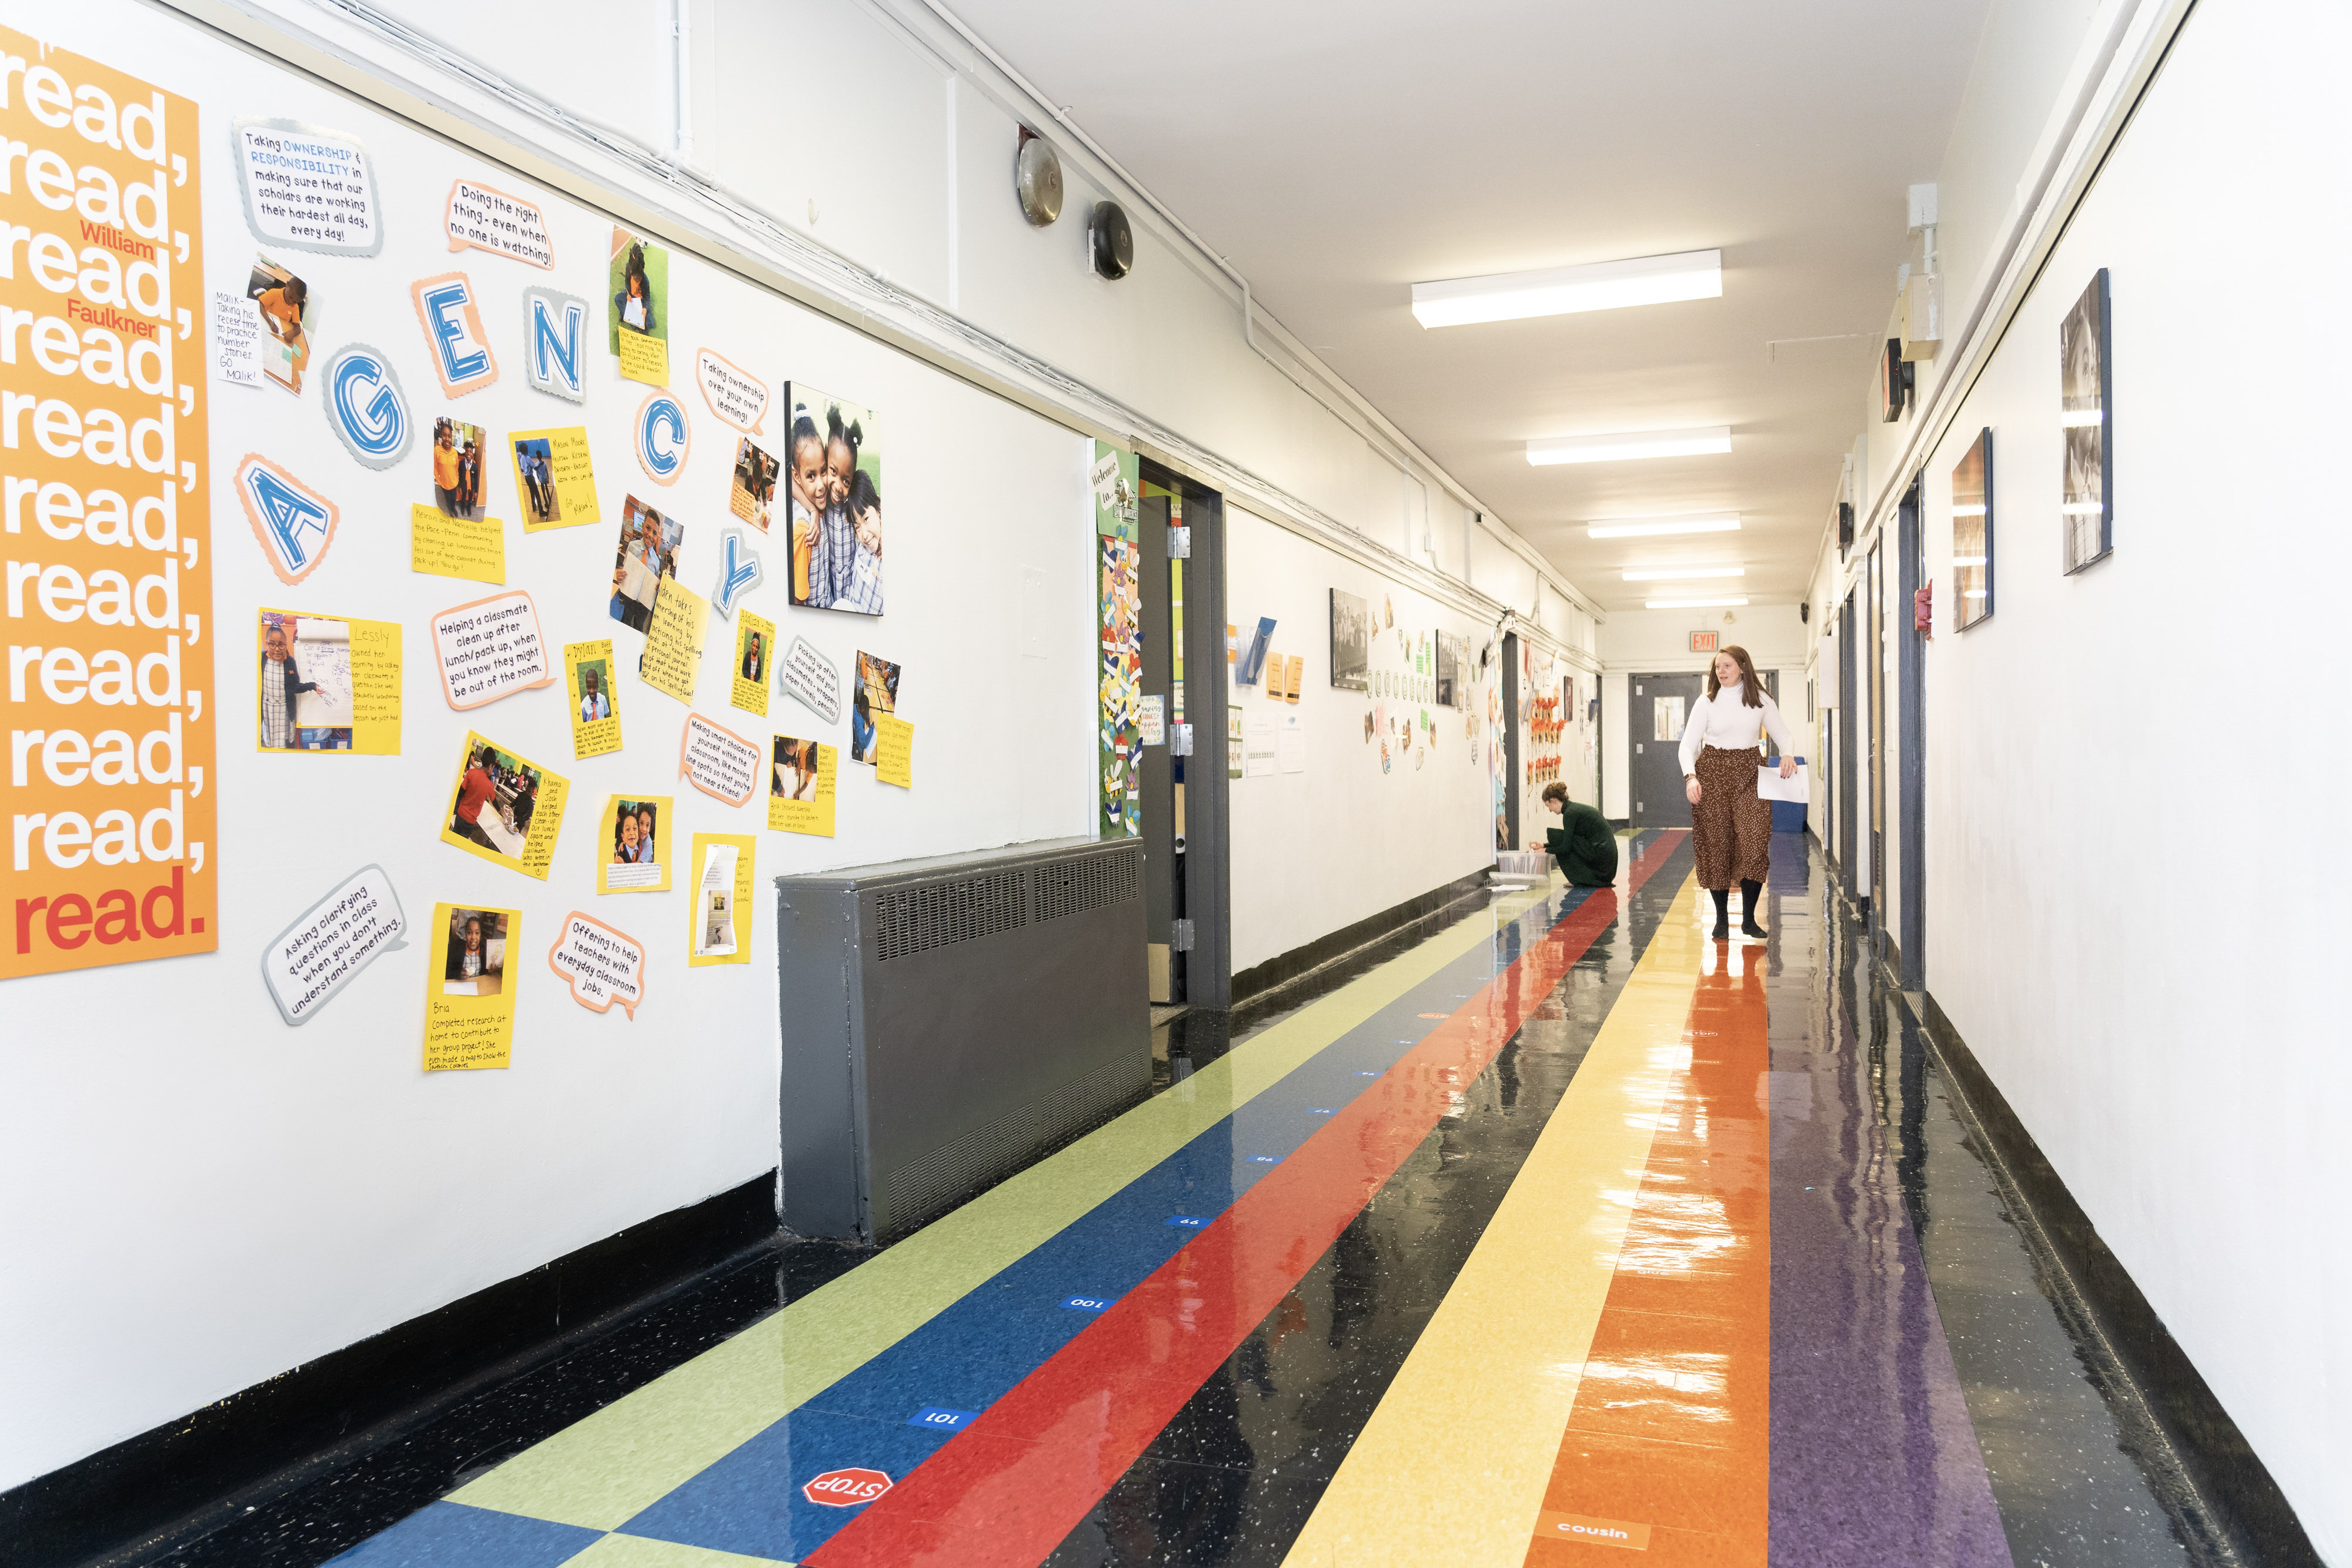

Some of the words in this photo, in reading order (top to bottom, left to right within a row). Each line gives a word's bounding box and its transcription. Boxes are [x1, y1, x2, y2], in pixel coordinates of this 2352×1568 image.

[0, 49, 188, 187] read,
[246, 133, 280, 152] Taking
[284, 141, 351, 160] OWNERSHIP
[252, 152, 348, 176] RESPONSIBILITY
[353, 168, 362, 178] in
[255, 170, 290, 187] making
[295, 178, 318, 188] sure
[322, 179, 343, 191] that
[348, 185, 362, 194] our
[0, 135, 189, 263] read,
[259, 188, 301, 202] scholars
[306, 196, 322, 204] are
[326, 198, 365, 213] working
[462, 186, 491, 209] Doing
[495, 198, 512, 213] the
[516, 207, 538, 223] right
[261, 203, 286, 217] their
[290, 209, 330, 222] hardest
[334, 213, 345, 223] all
[348, 215, 368, 229] day,
[493, 218, 517, 235] even
[520, 228, 546, 245] when
[80, 220, 154, 260] William
[291, 226, 320, 239] every
[325, 228, 345, 242] day!
[451, 222, 464, 234] no
[469, 229, 487, 242] one
[491, 233, 499, 246] is
[503, 240, 551, 266] watching!
[0, 219, 191, 341] read,
[68, 299, 156, 339] Faulkner
[218, 303, 240, 319] Taking
[243, 309, 253, 319] his
[218, 314, 239, 326] recess
[242, 320, 259, 330] time
[218, 324, 225, 333] to
[227, 327, 257, 339] practice
[218, 336, 249, 348] number
[0, 305, 194, 417] read,
[220, 356, 232, 367] GO
[226, 370, 256, 381] Malik!
[703, 359, 727, 382] Taking
[729, 376, 764, 402] ownership
[709, 380, 724, 393] over
[727, 390, 741, 403] your
[744, 400, 758, 413] own
[718, 398, 747, 424] learning!
[2, 390, 196, 494] read,
[1092, 462, 1115, 487] Welcome
[5, 474, 198, 570] read,
[7, 557, 200, 646] read,
[440, 618, 474, 635] Helping
[485, 604, 527, 623] classmate
[457, 634, 481, 647] clean
[484, 631, 493, 640] up
[496, 623, 520, 636] after
[355, 626, 389, 648] Lessly
[446, 644, 496, 667] lunch/pack
[499, 642, 512, 652] up,
[514, 634, 536, 647] when
[574, 644, 596, 660] Dylan
[1693, 634, 1716, 650] EXIT
[9, 635, 202, 722] read,
[450, 671, 466, 684] you
[467, 663, 490, 677] know
[494, 657, 513, 668] they
[517, 647, 538, 663] might
[795, 655, 816, 675] yourself
[816, 672, 824, 683] and
[826, 680, 835, 692] your
[799, 644, 816, 665] Picking
[817, 661, 822, 670] up
[823, 668, 836, 681] after
[455, 687, 466, 697] be
[470, 680, 484, 693] out
[488, 677, 496, 687] of
[500, 671, 515, 683] the
[518, 665, 542, 678] room.
[786, 673, 799, 687] paper
[800, 684, 816, 704] towels,
[818, 700, 836, 719] pencils!
[817, 686, 838, 710] wrappers,
[11, 712, 203, 798] read,
[691, 720, 710, 734] Making
[711, 731, 726, 744] smart
[728, 741, 747, 756] choices
[749, 750, 757, 760] for
[698, 737, 720, 753] yourself
[722, 748, 737, 761] within
[739, 757, 747, 767] the
[686, 754, 696, 764] line
[697, 761, 712, 773] spots
[721, 771, 733, 783] that
[734, 779, 750, 791] you're
[691, 745, 720, 767] classroom,
[721, 760, 730, 770] like
[733, 766, 749, 781] moving
[693, 771, 703, 780] not
[704, 777, 716, 788] near
[721, 785, 740, 800] friend!
[14, 789, 204, 874] read,
[16, 865, 204, 955] read.
[286, 926, 319, 959] Asking
[320, 886, 368, 930] clarifying
[289, 930, 339, 975] questions
[340, 920, 351, 932] in
[352, 898, 377, 922] class
[303, 957, 331, 983] when
[333, 941, 350, 960] you
[353, 917, 376, 941] don't
[573, 922, 610, 950] Offering
[612, 942, 620, 952] to
[622, 947, 637, 964] help
[292, 961, 348, 1014] understand
[350, 918, 400, 964] something.
[557, 952, 594, 977] everyday
[597, 969, 636, 994] classroom
[574, 940, 610, 965] teachers
[613, 961, 629, 974] with
[583, 979, 603, 997] jobs.
[434, 1002, 449, 1014] Bria
[467, 1015, 495, 1025] research
[1071, 1299, 1104, 1309] 100
[925, 1413, 960, 1425] 101
[813, 1477, 883, 1497] STOP
[1557, 1523, 1628, 1539] cousin
